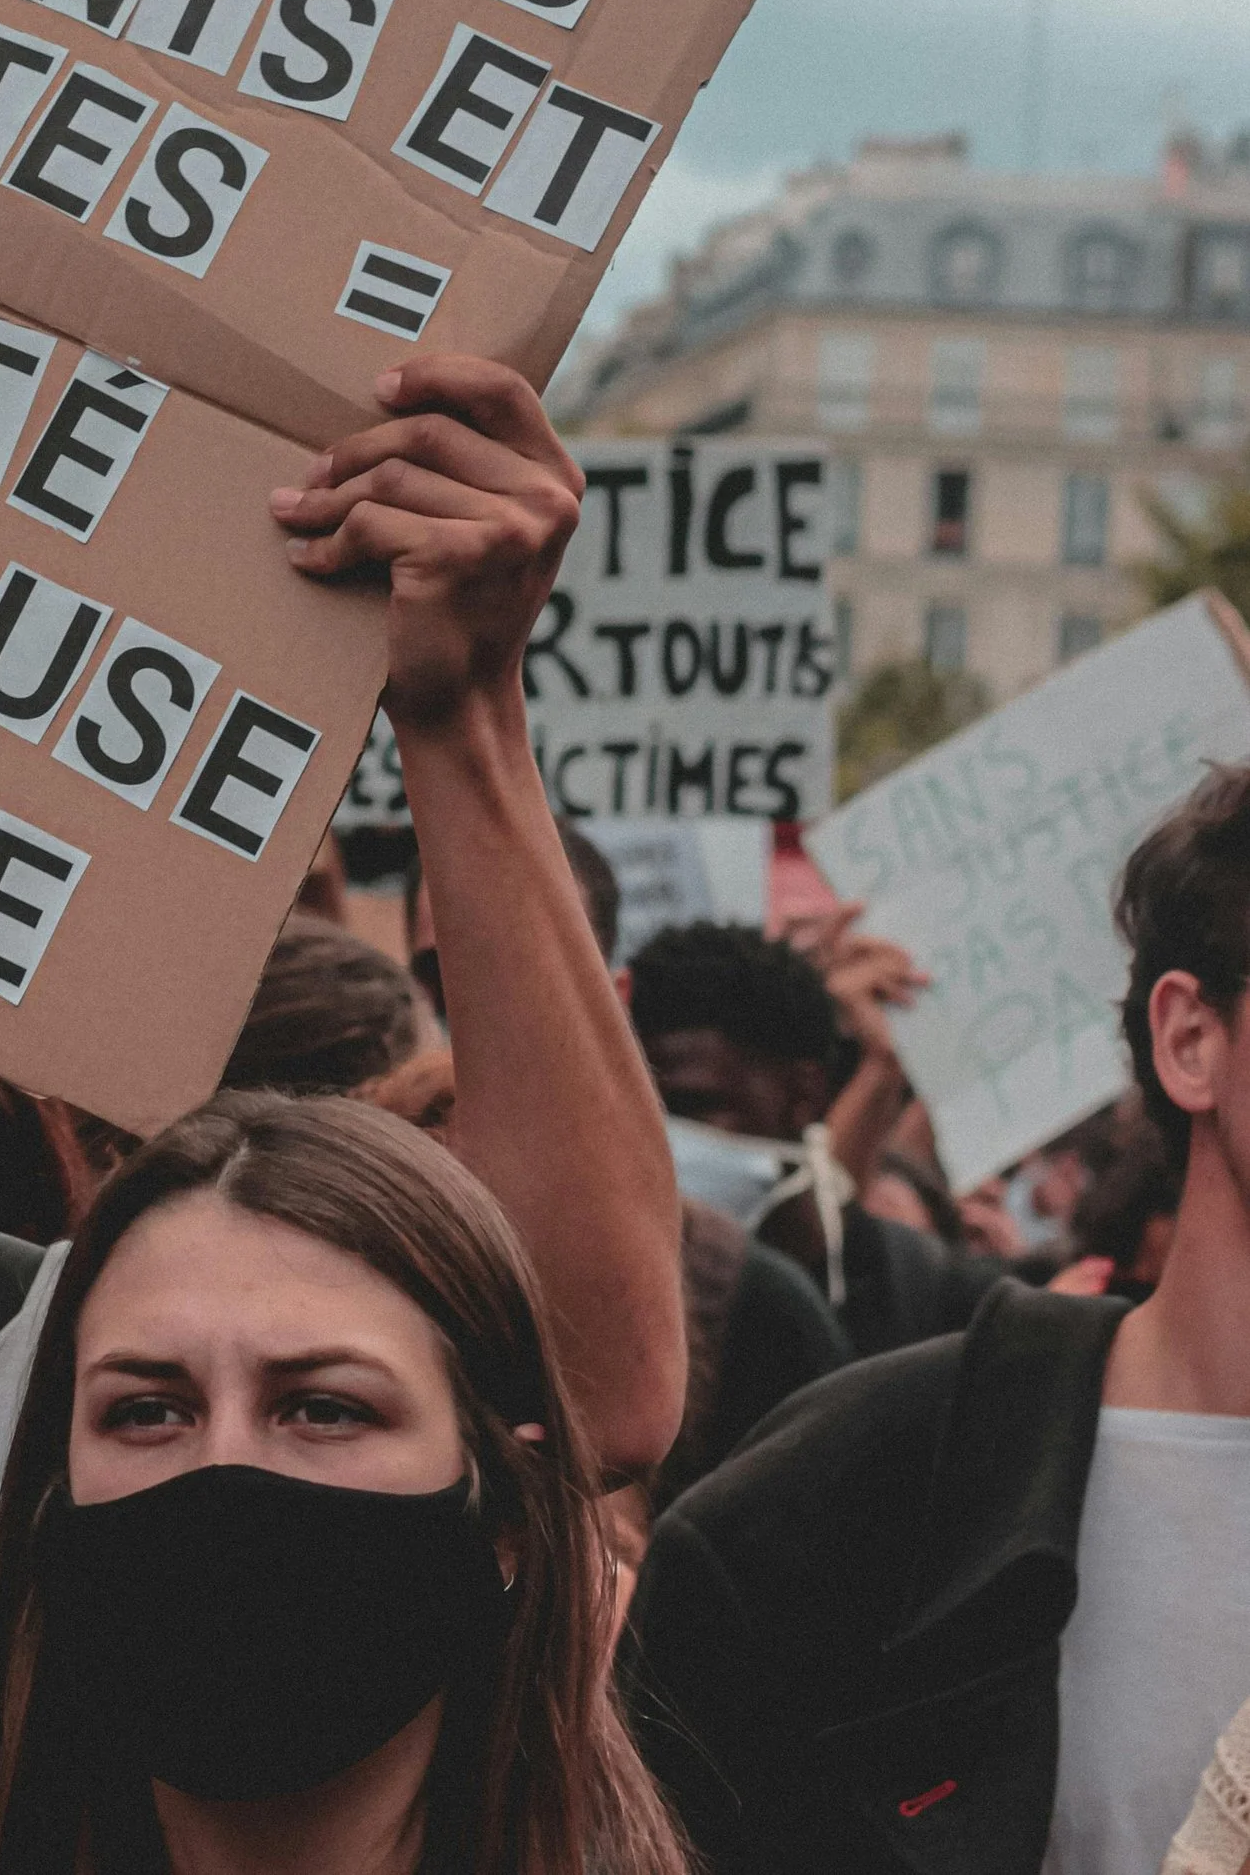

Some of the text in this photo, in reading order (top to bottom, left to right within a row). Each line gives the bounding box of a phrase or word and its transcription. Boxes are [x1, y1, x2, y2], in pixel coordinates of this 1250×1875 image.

[406, 35, 653, 226] ET
[583, 443, 823, 582] TICE
[533, 729, 806, 818] ICTIMES
